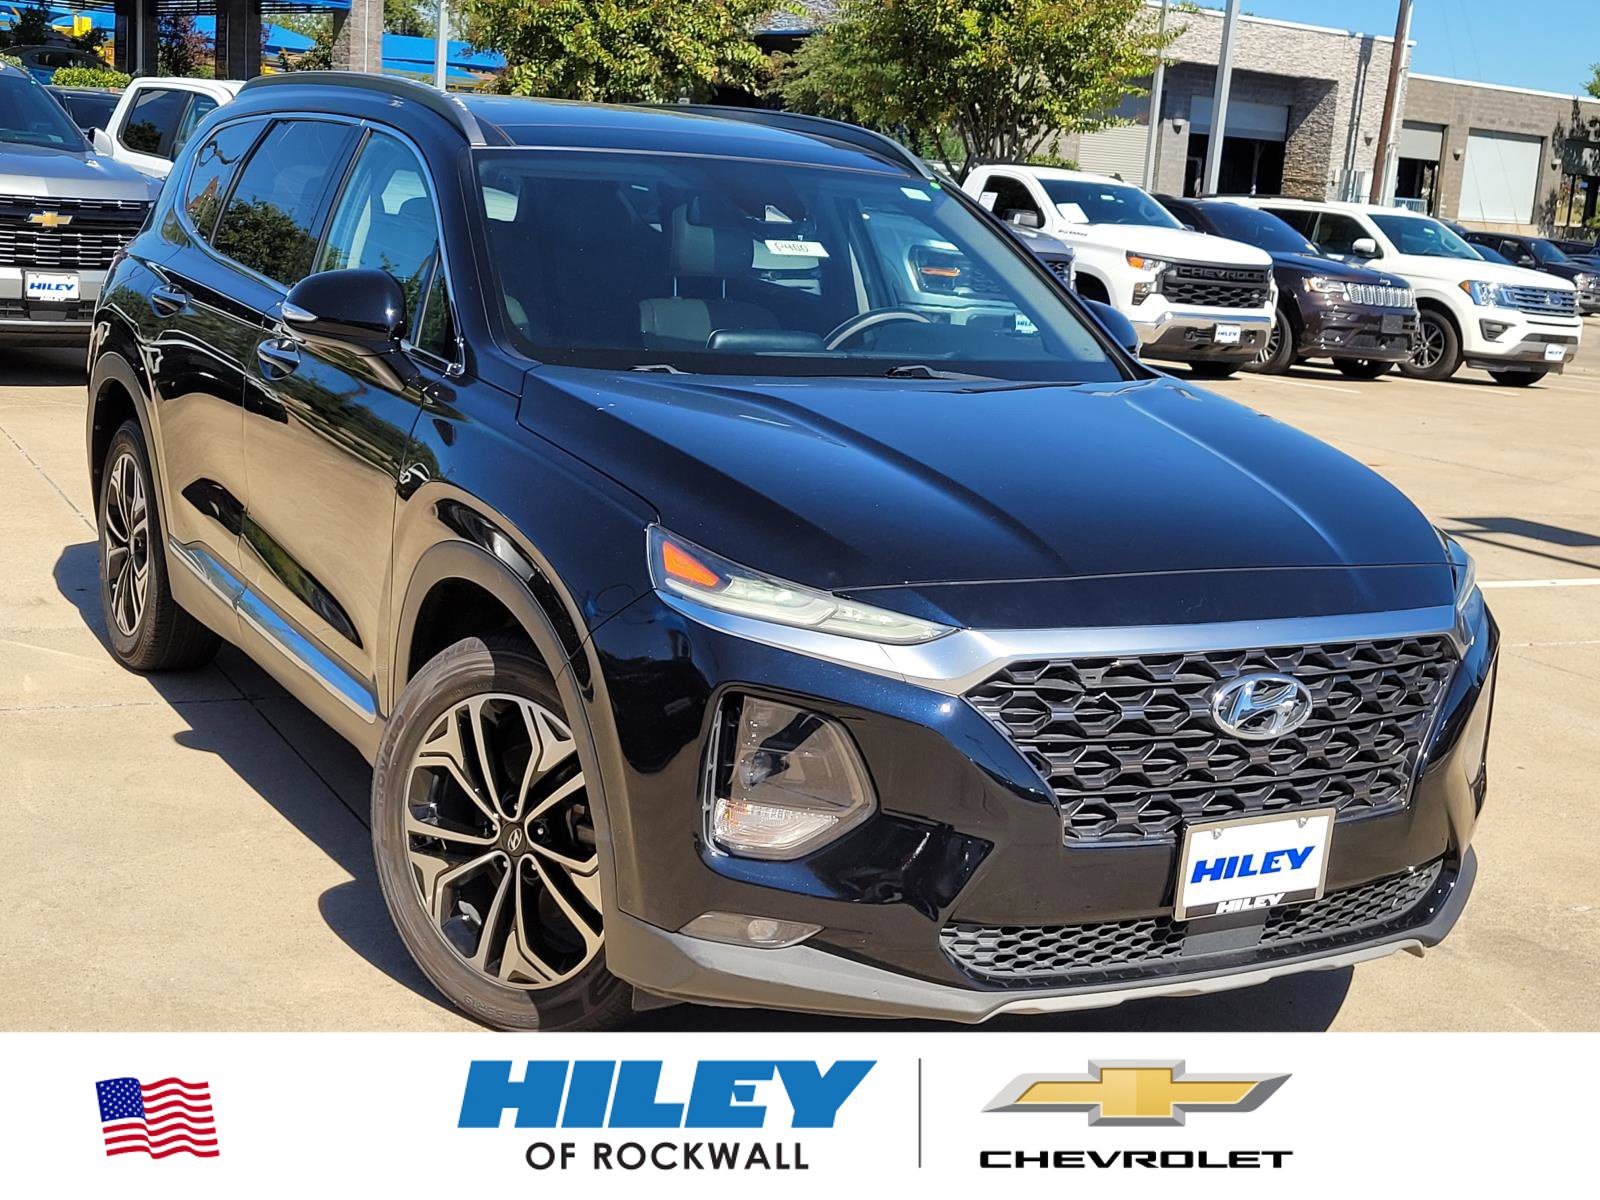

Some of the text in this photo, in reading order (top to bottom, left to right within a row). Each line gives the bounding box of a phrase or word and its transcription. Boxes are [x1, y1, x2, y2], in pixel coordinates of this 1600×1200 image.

[29, 282, 75, 291] HILEY
[1190, 845, 1316, 884] HILEY
[1215, 891, 1287, 915] HILEY
